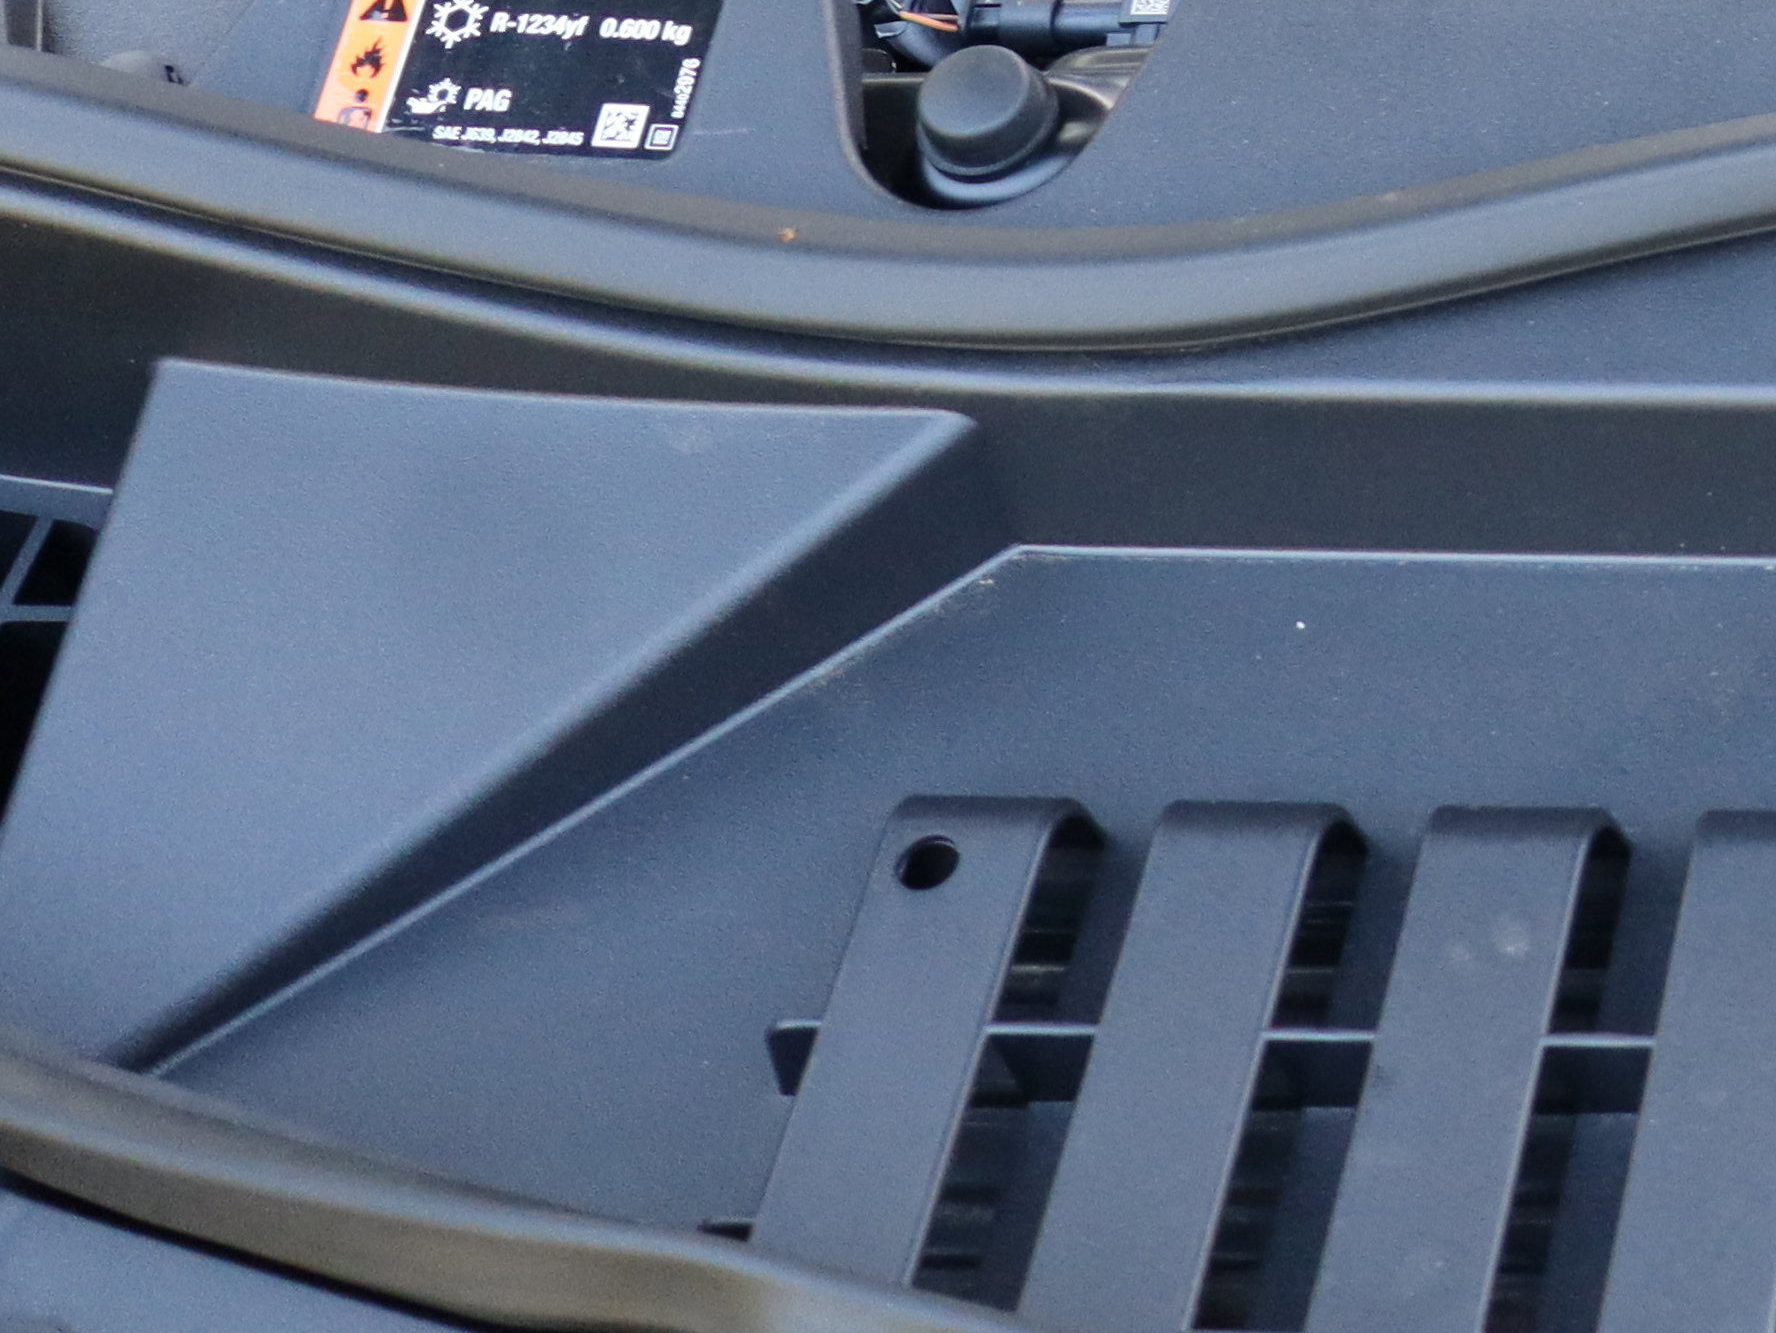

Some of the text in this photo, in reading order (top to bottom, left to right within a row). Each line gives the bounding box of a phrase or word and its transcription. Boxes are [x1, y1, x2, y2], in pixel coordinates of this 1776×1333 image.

[490, 11, 694, 46] R-1234yf 0.600 kg
[463, 87, 513, 112] PAG
[432, 125, 463, 140] SAE
